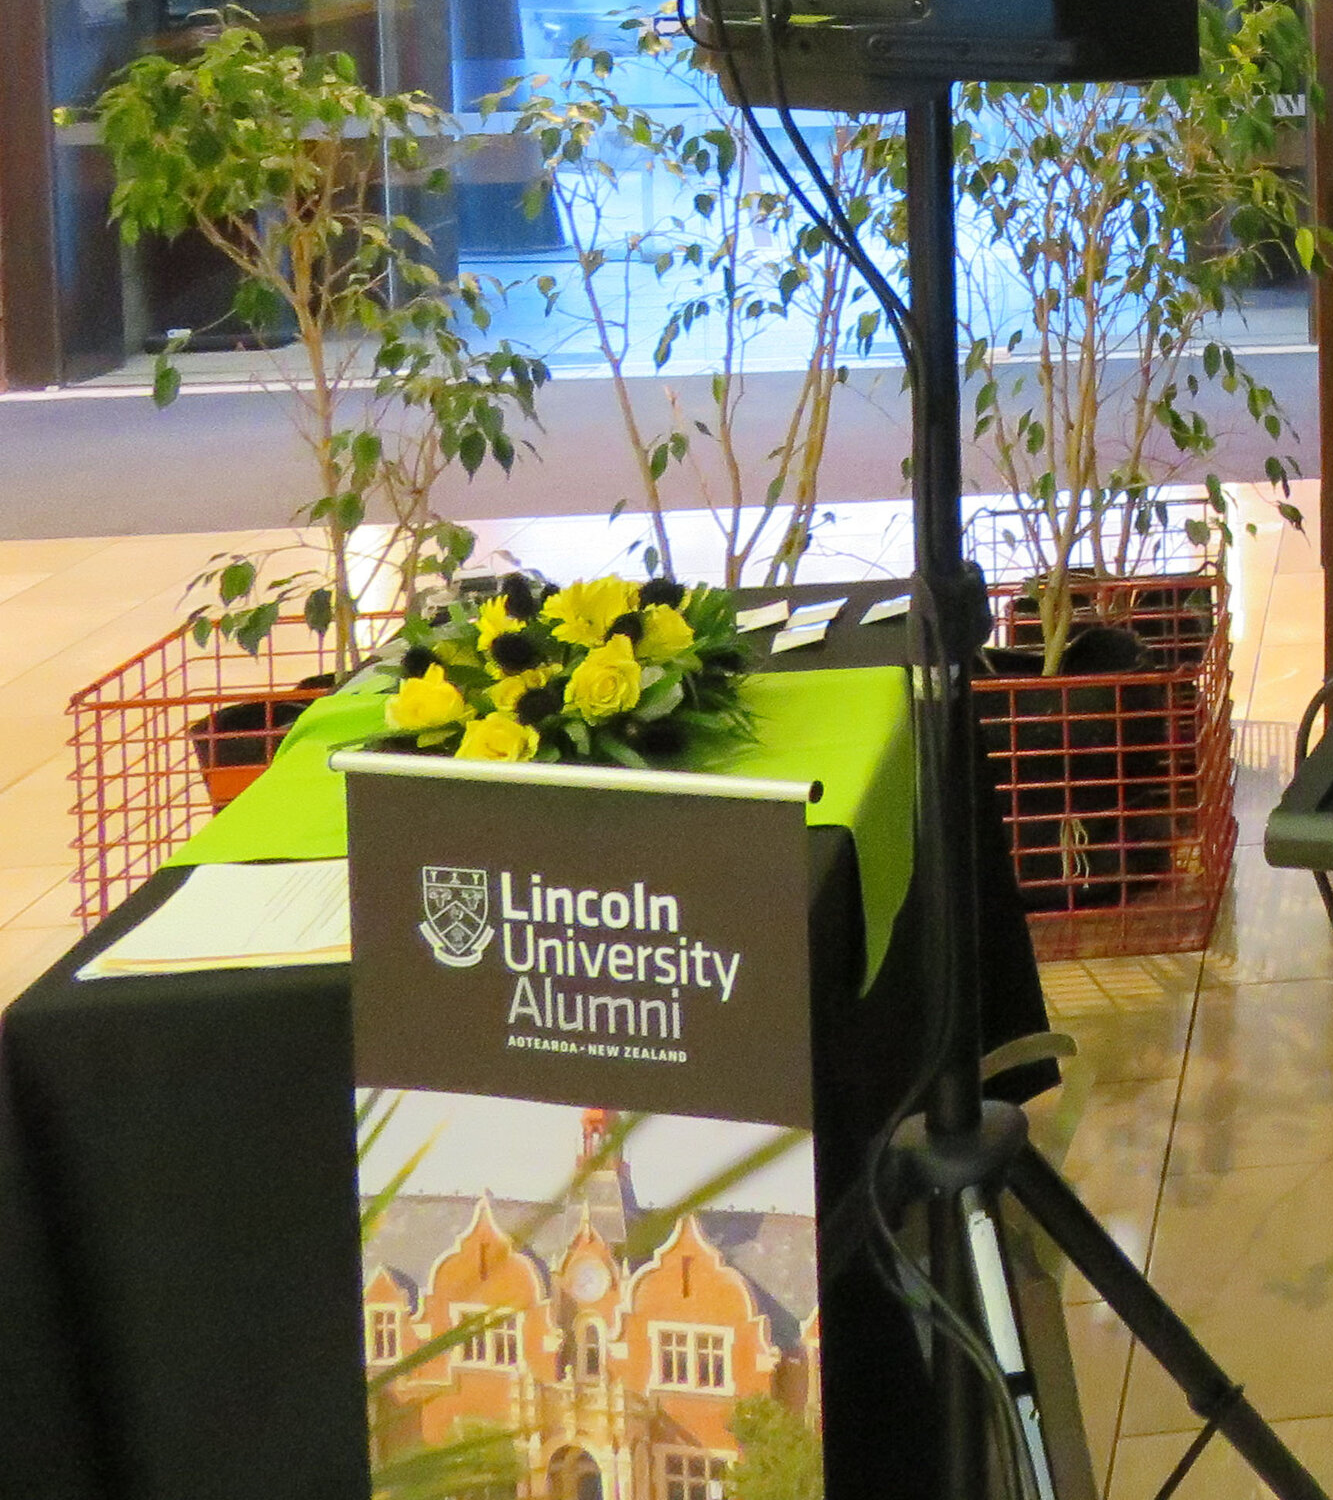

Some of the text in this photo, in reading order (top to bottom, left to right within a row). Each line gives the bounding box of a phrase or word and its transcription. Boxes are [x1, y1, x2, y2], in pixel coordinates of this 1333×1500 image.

[501, 871, 679, 933] Lincoln
[502, 922, 740, 1003] University
[508, 975, 681, 1039] Alumni
[588, 1044, 620, 1058] NEW
[623, 1046, 687, 1063] ZEALAND
